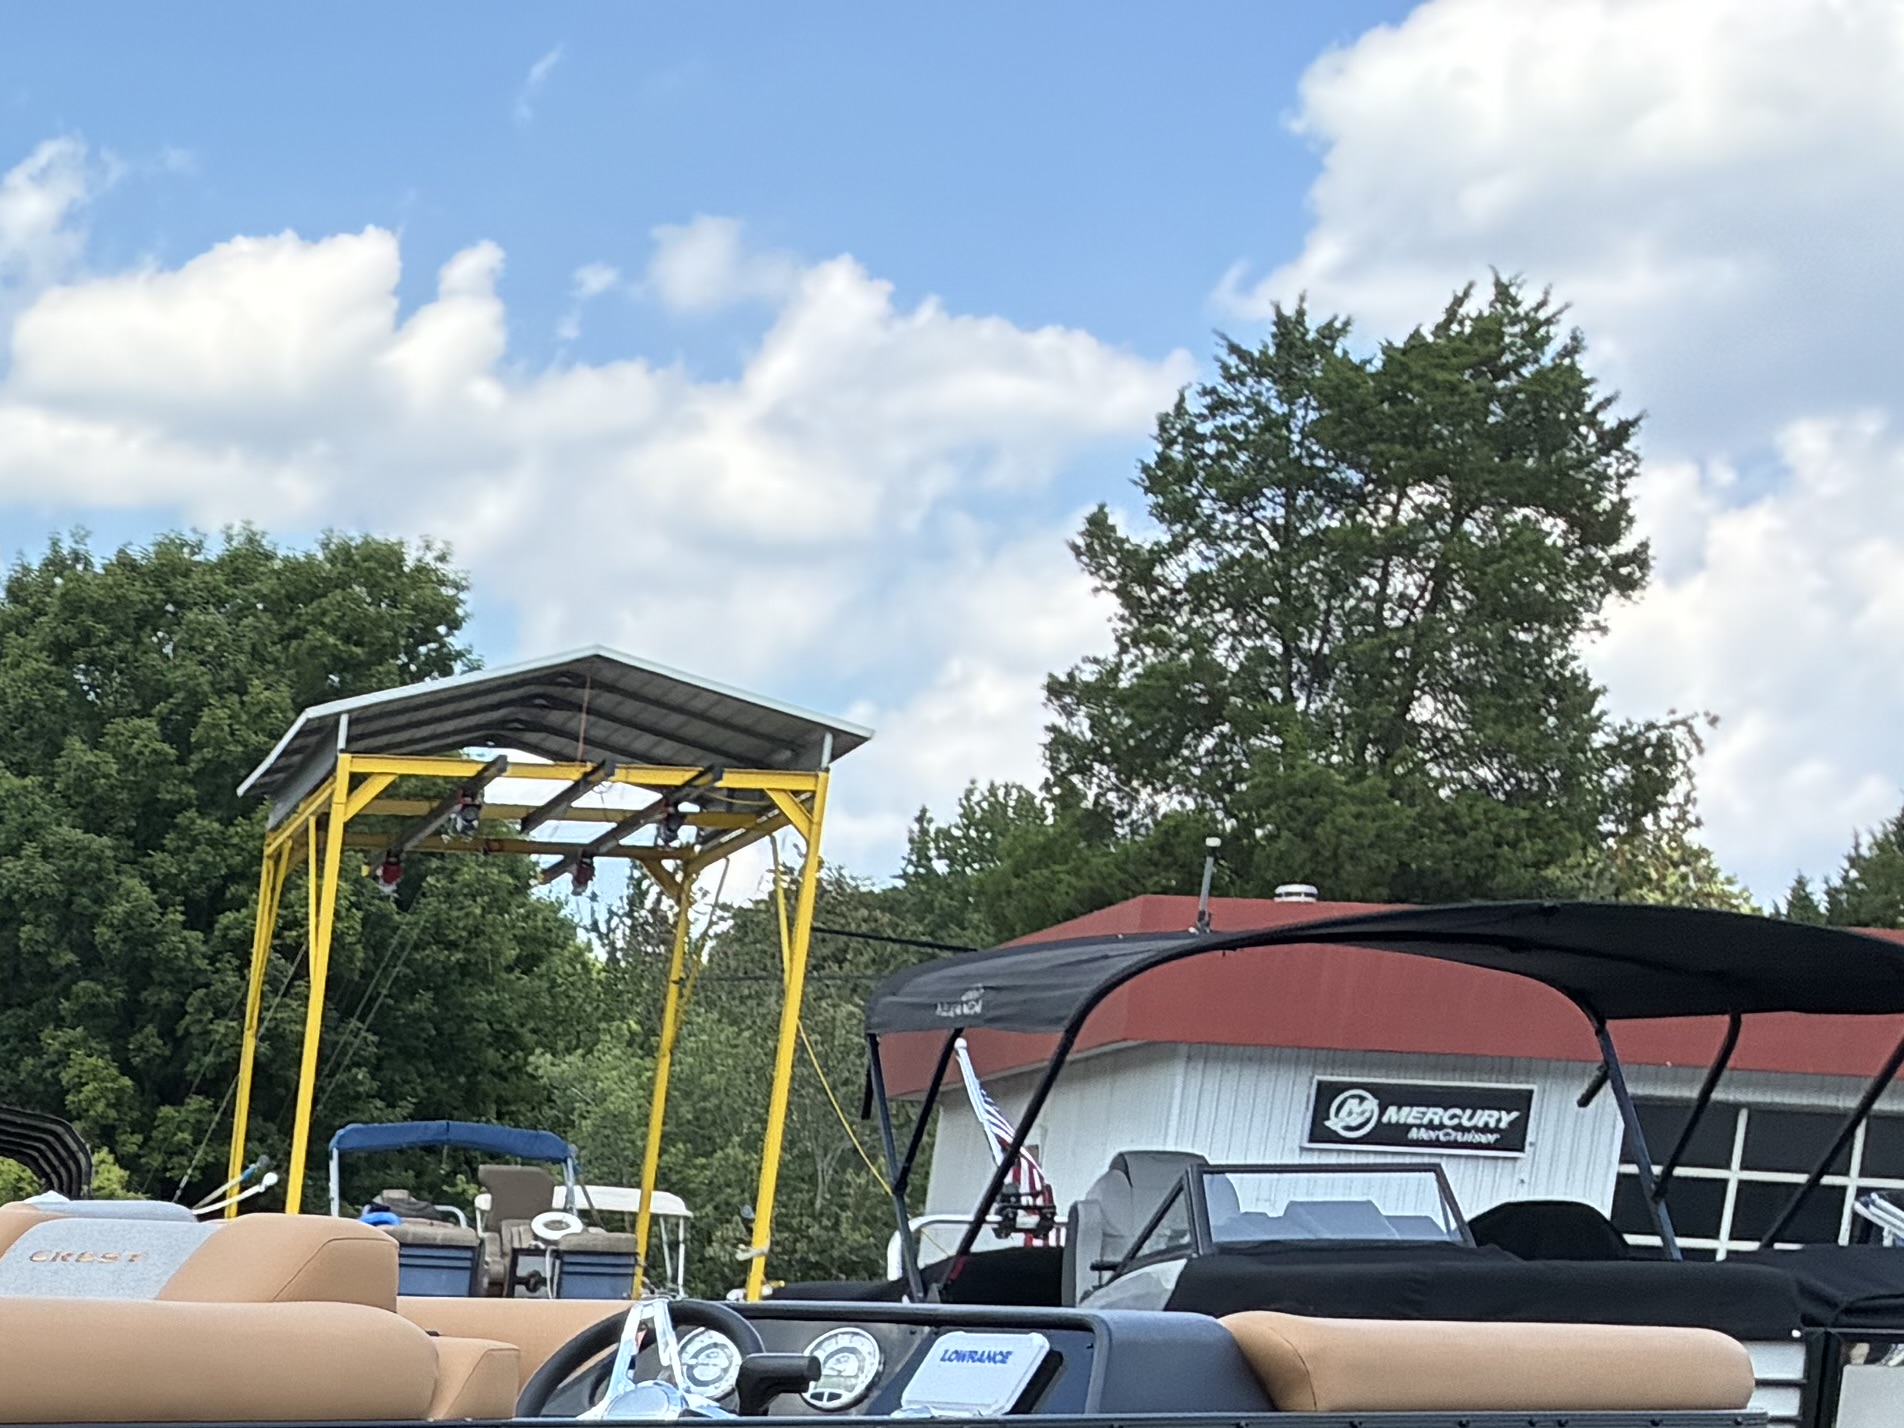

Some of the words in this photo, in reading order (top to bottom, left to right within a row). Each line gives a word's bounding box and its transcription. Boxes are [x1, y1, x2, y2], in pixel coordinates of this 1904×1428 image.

[1382, 1106, 1520, 1129] MERCURY
[1408, 1126, 1501, 1144] MerCruiser
[939, 1349, 1013, 1364] LOWRANCE
